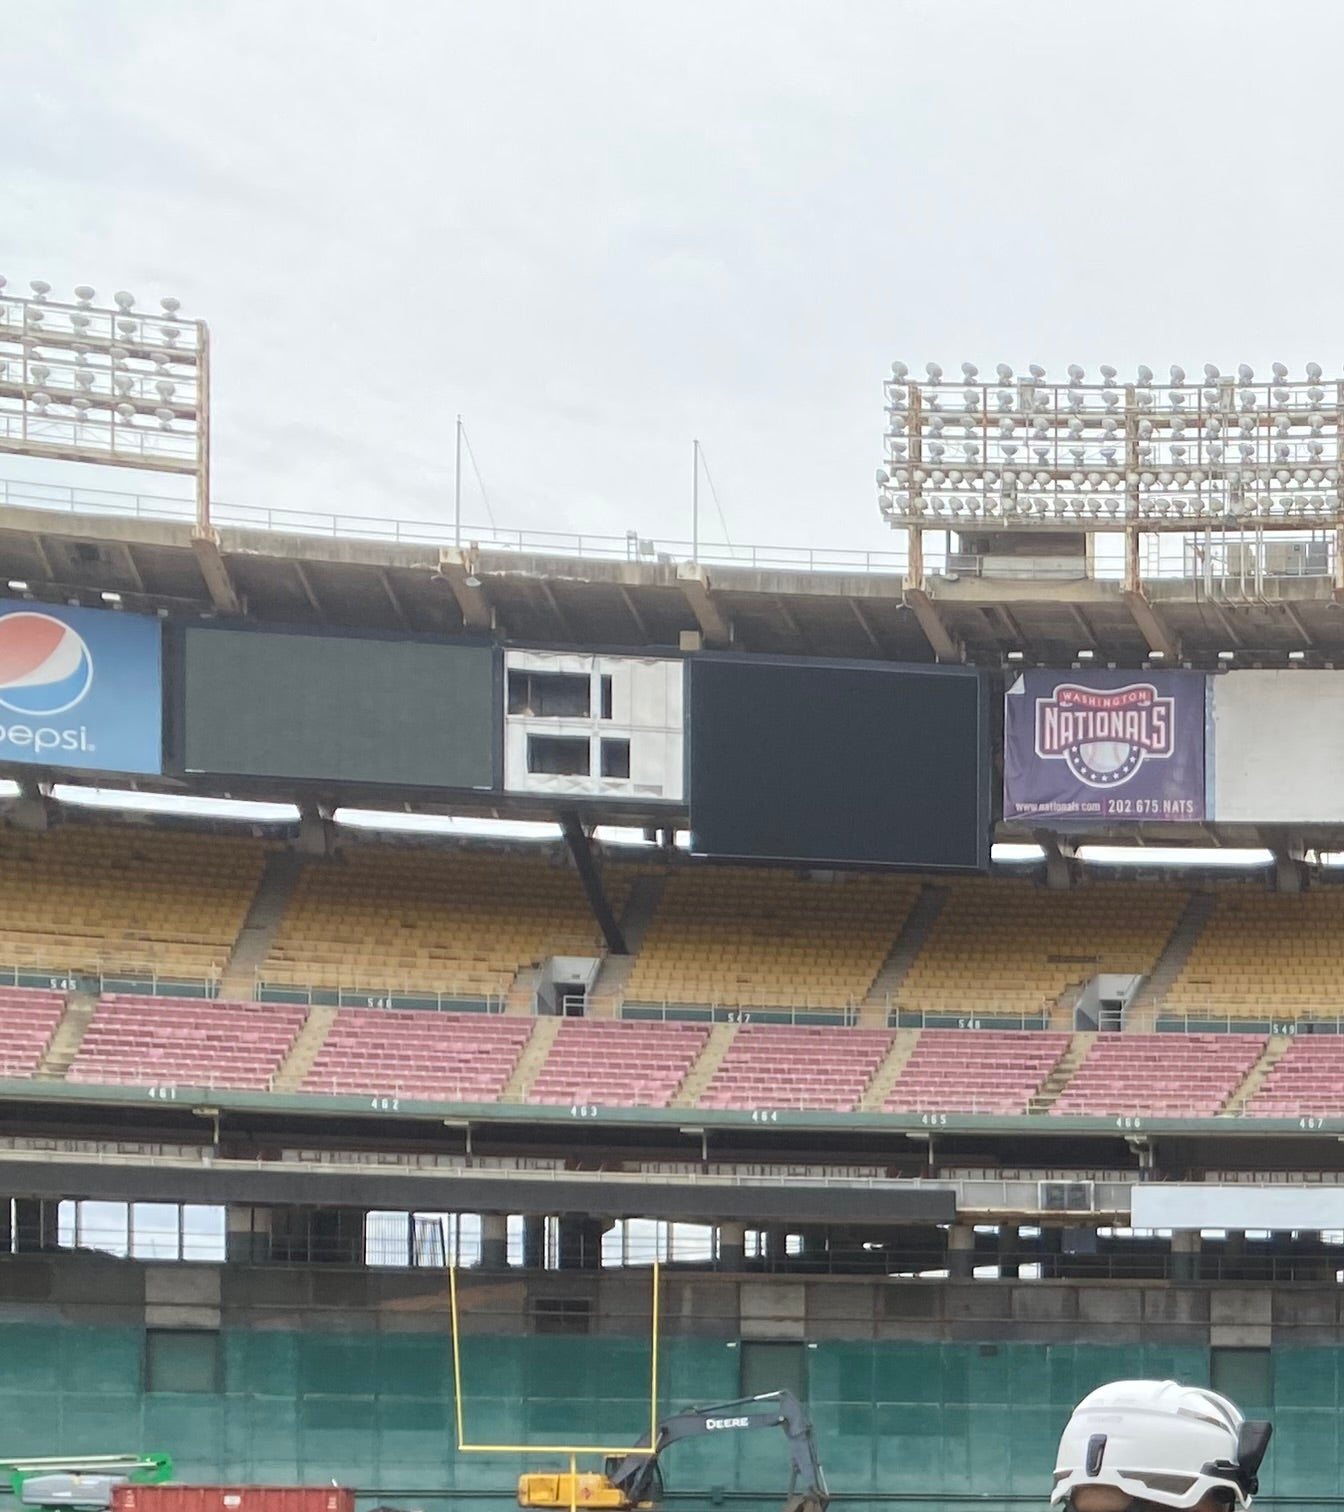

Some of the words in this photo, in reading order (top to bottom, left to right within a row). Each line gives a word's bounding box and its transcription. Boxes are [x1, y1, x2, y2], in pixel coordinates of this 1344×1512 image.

[1062, 691, 1148, 708] WASHINGTON
[1043, 705, 1167, 751] NATIONALS
[0, 724, 87, 753] epsi
[50, 979, 77, 991] 545
[148, 1088, 176, 1100] 461
[371, 1098, 399, 1111] 462
[571, 1106, 598, 1118] 463
[752, 1111, 777, 1122] 464
[922, 1114, 947, 1125] 465
[1116, 1118, 1141, 1128] 466
[1299, 1118, 1323, 1129] 467
[706, 1417, 749, 1430] DEERE
